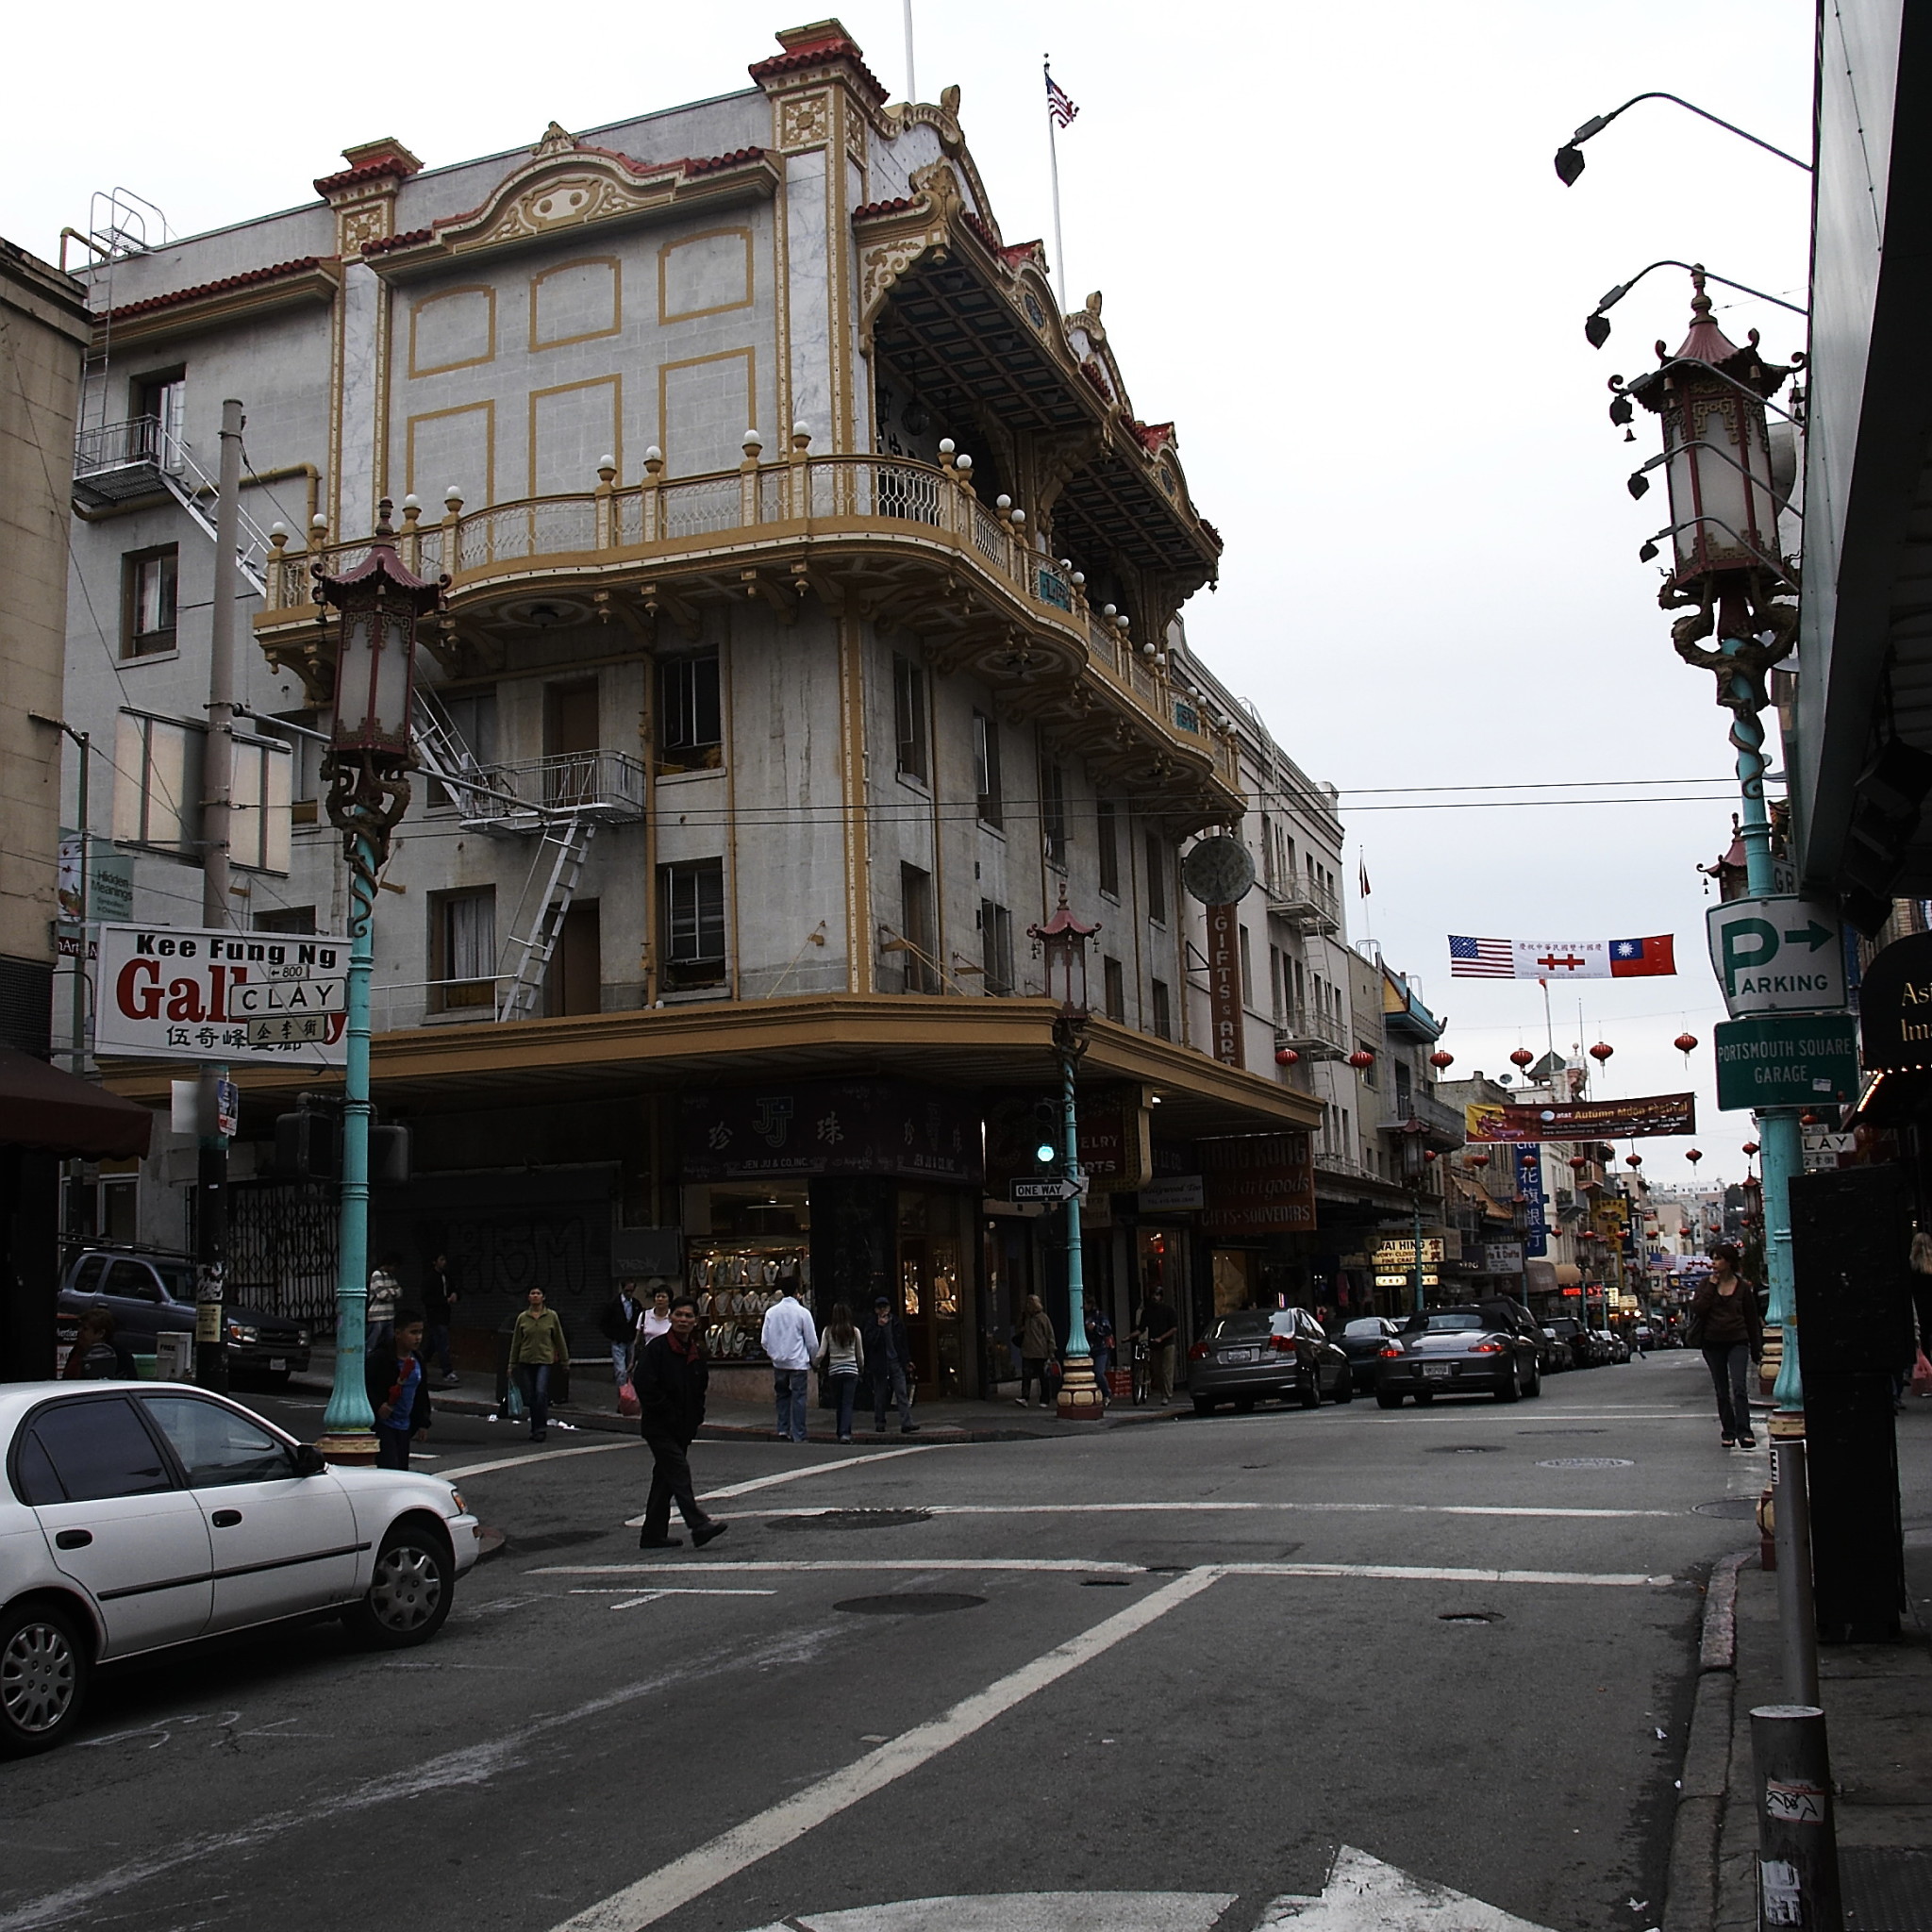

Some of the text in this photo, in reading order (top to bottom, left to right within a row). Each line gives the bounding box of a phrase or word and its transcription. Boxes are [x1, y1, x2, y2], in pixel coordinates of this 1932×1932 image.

[97, 870, 129, 888] Hidden
[92, 879, 133, 902] Meanings
[136, 934, 338, 970] Kee Fung Ng
[1214, 915, 1231, 1000] GIFTS
[281, 966, 304, 978] 800
[242, 984, 335, 1011] CLAY
[1718, 1038, 1852, 1063] PORTSMOUTH SQUARE
[1754, 1065, 1808, 1084] GARAGE
[1574, 1110, 1615, 1120] Autumn
[1079, 1134, 1120, 1150] ELRY
[1803, 1136, 1848, 1151] LAY
[1255, 1137, 1307, 1168] KONG
[741, 1158, 759, 1171] JEN
[760, 1158, 772, 1170] JU
[1018, 1185, 1062, 1195] ONE WAY
[1263, 1170, 1310, 1201] goods
[1201, 1204, 1311, 1226] GIFTS SOUVENIRS
